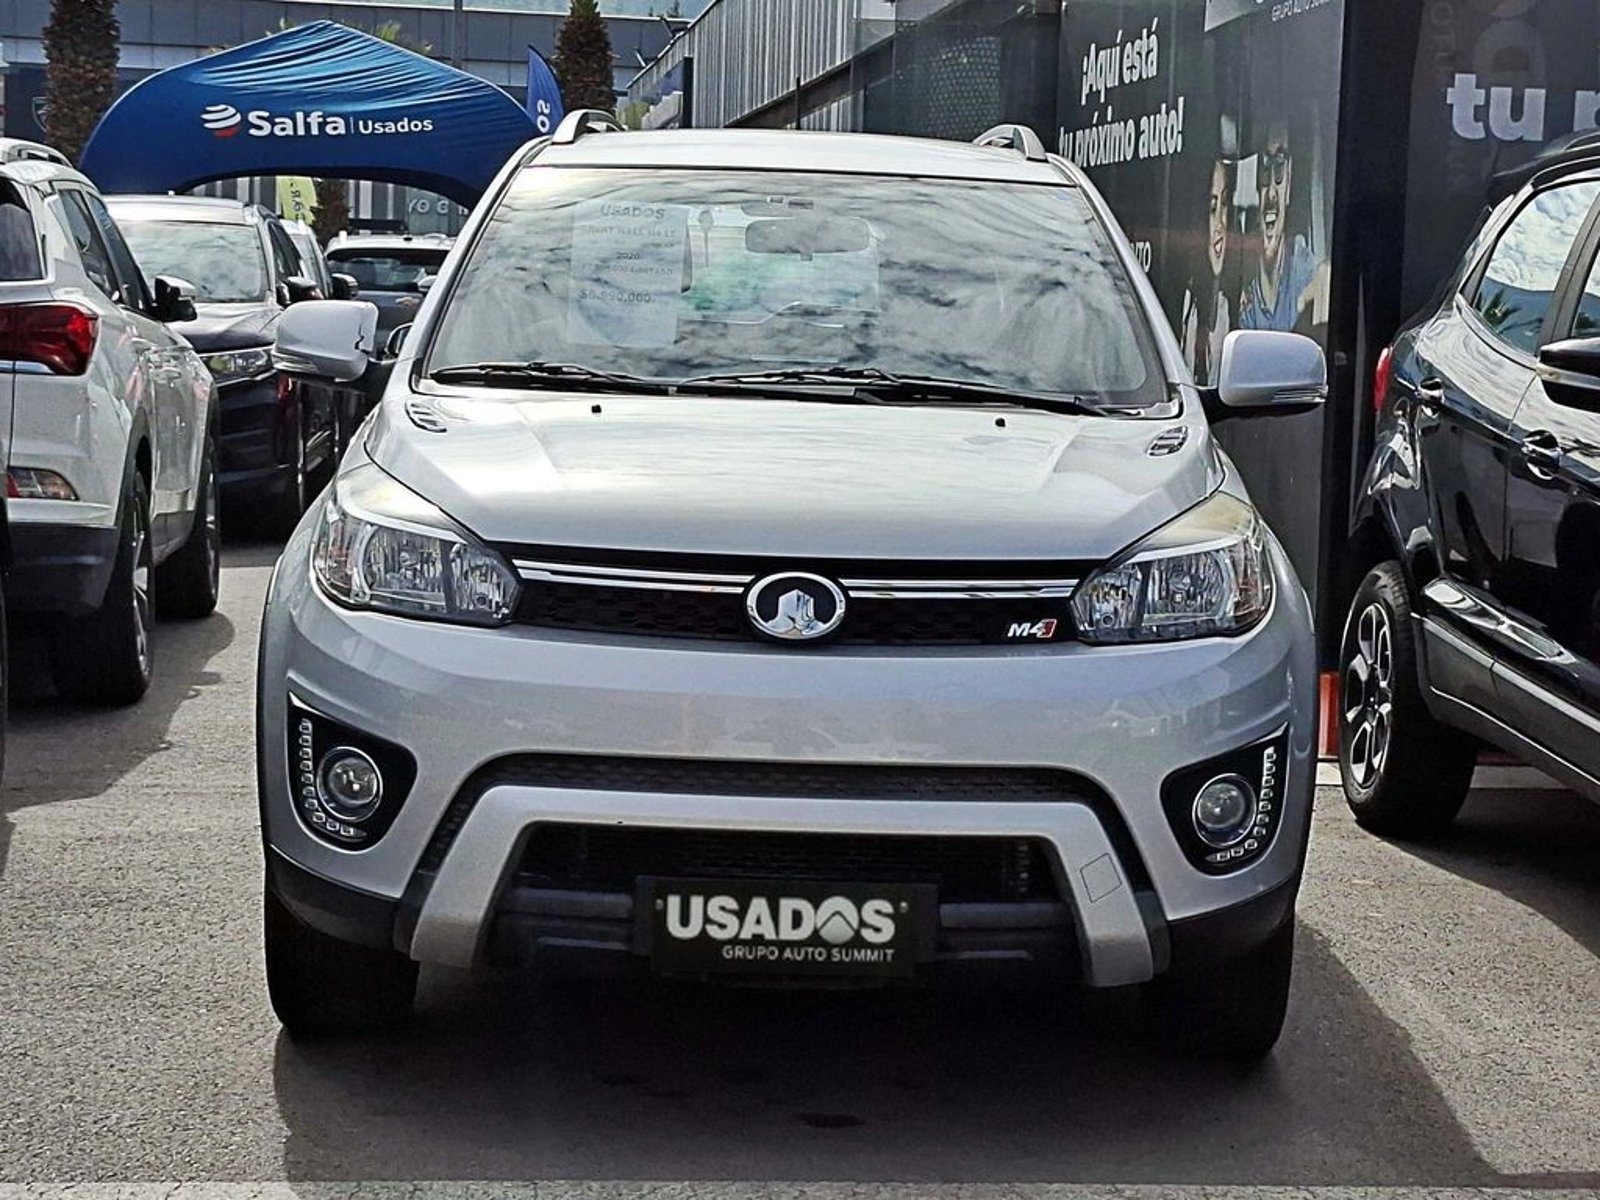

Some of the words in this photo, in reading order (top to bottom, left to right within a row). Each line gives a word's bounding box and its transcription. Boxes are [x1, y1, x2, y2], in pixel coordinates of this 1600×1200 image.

[1081, 29, 1123, 106] ¡Aquí
[1122, 17, 1159, 84] está
[247, 110, 346, 137] Salfa
[358, 117, 434, 134] Usados
[1058, 126, 1074, 160] tu
[1074, 105, 1135, 167] próximo
[1138, 96, 1185, 160] auto!
[1446, 73, 1546, 141] tu
[1007, 618, 1057, 638] M4
[665, 894, 896, 944] USADOS
[722, 945, 780, 961] GRUPO
[782, 946, 828, 962] AUTO
[830, 948, 895, 963] SUMMIT
